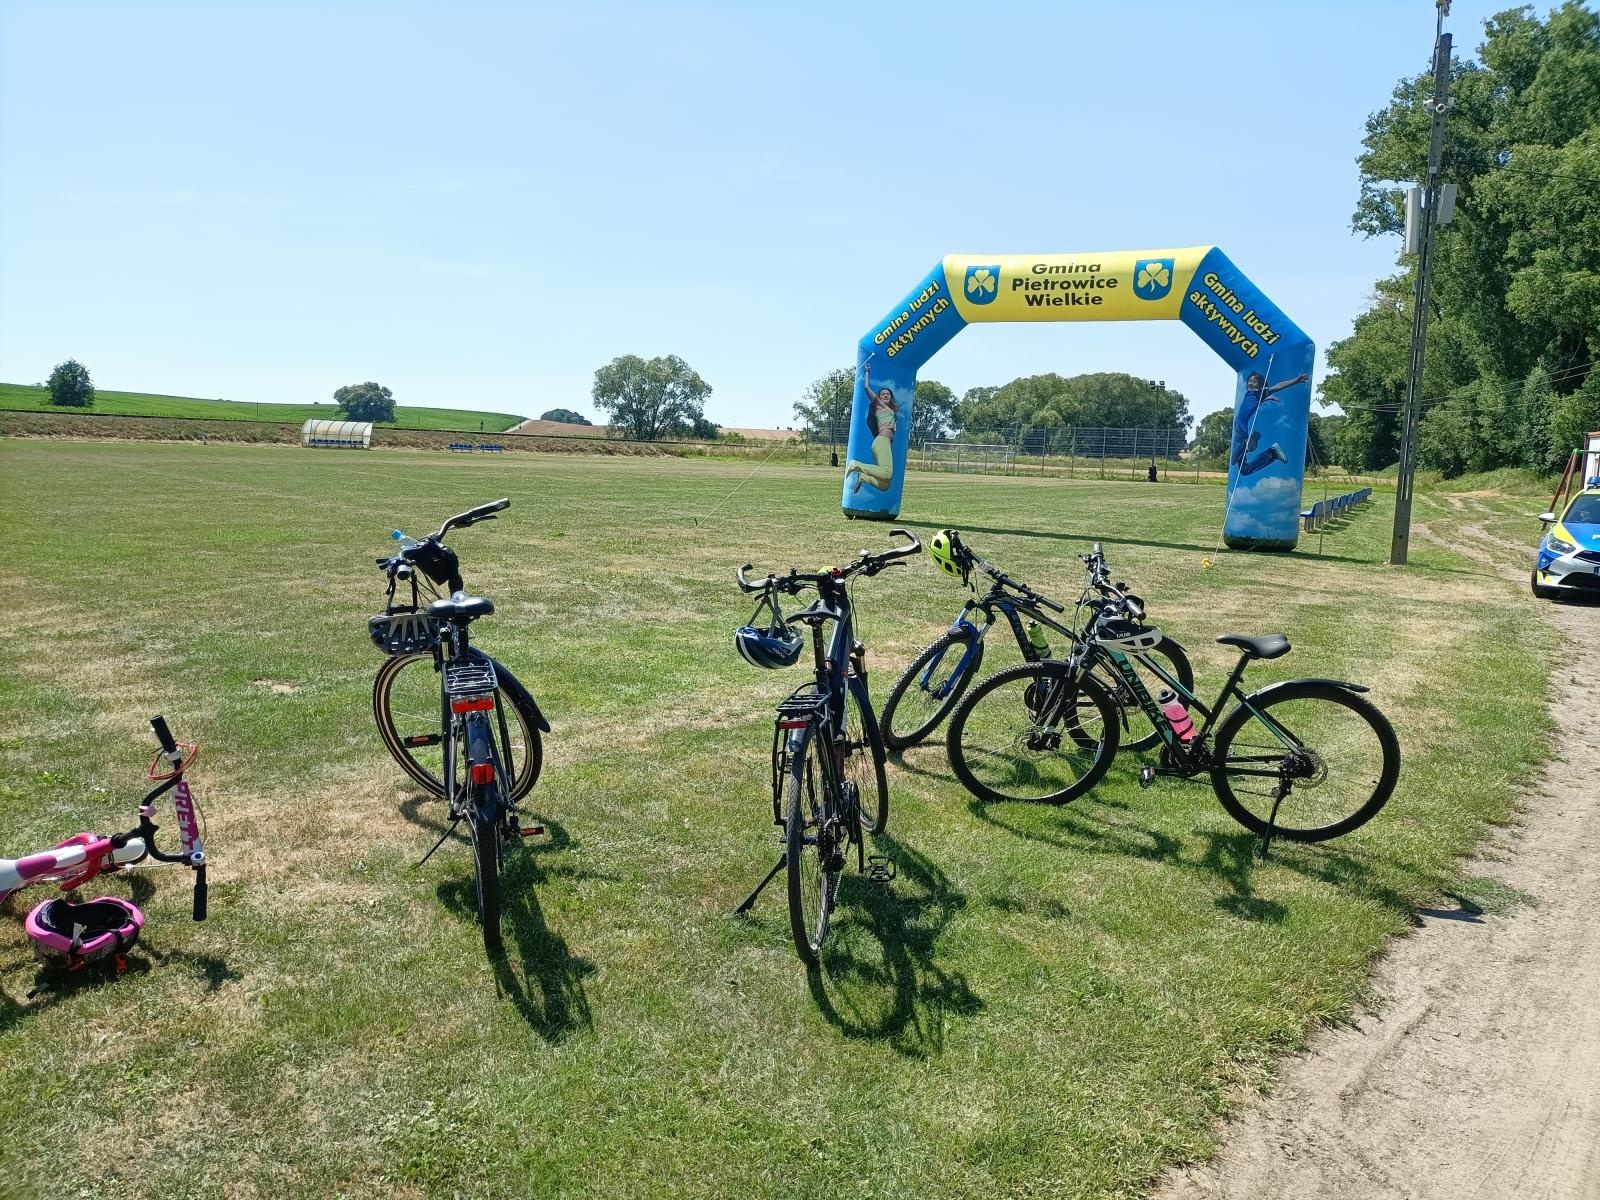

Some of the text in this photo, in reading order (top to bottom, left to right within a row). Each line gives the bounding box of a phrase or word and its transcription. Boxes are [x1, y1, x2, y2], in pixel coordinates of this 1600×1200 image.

[1011, 275, 1119, 292] Pietrowice
[1024, 292, 1104, 307] Wielkie
[1031, 262, 1102, 275] Gmina
[873, 279, 941, 345] Gmina ludzi
[885, 296, 951, 358] aktywnych
[1188, 289, 1260, 359] aktywnych
[1203, 272, 1281, 346] Gmina ludzi
[1117, 658, 1171, 735] UNIBIKE
